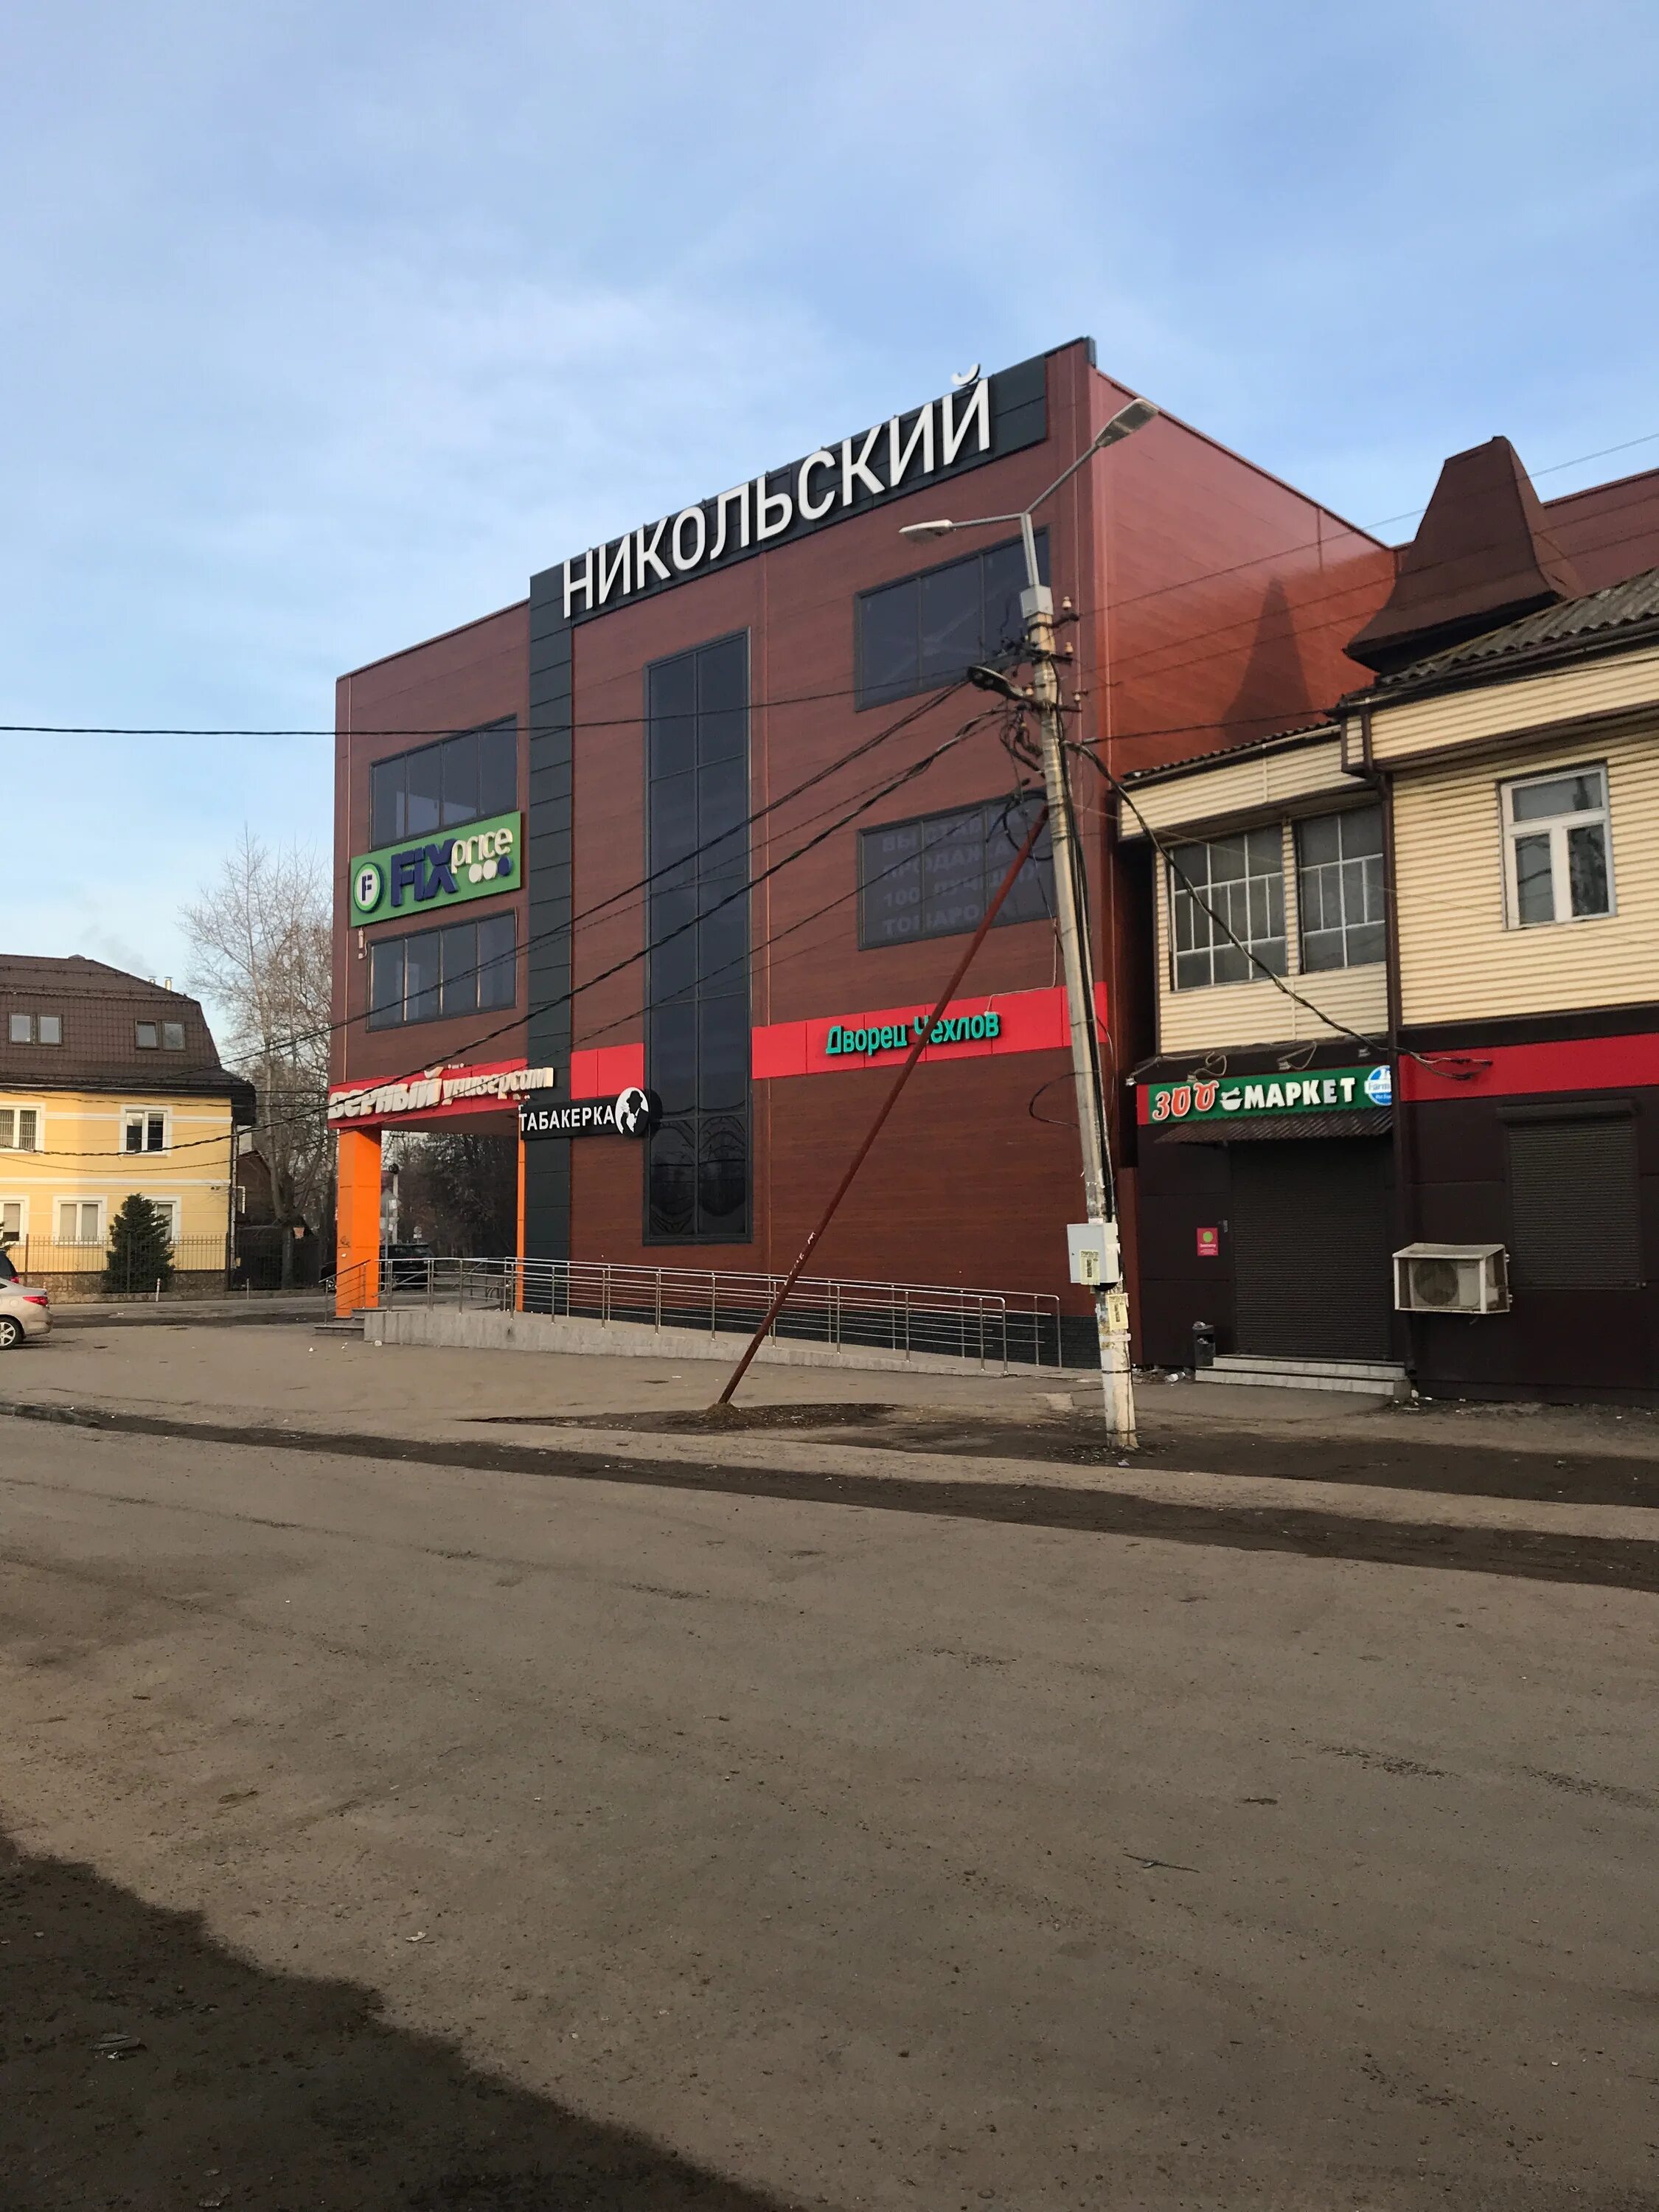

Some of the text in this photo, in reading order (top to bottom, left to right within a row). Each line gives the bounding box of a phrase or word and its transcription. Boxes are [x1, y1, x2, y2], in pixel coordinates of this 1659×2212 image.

[563, 364, 990, 619] НИКОЛЬСКИЙ
[451, 828, 513, 874] price
[361, 874, 373, 901] F
[826, 1023, 907, 1056] Дворец
[442, 1067, 554, 1106] универсам
[1244, 1077, 1355, 1110] МАРКЕТ
[518, 1105, 615, 1132] ТАБАКЕРКА
